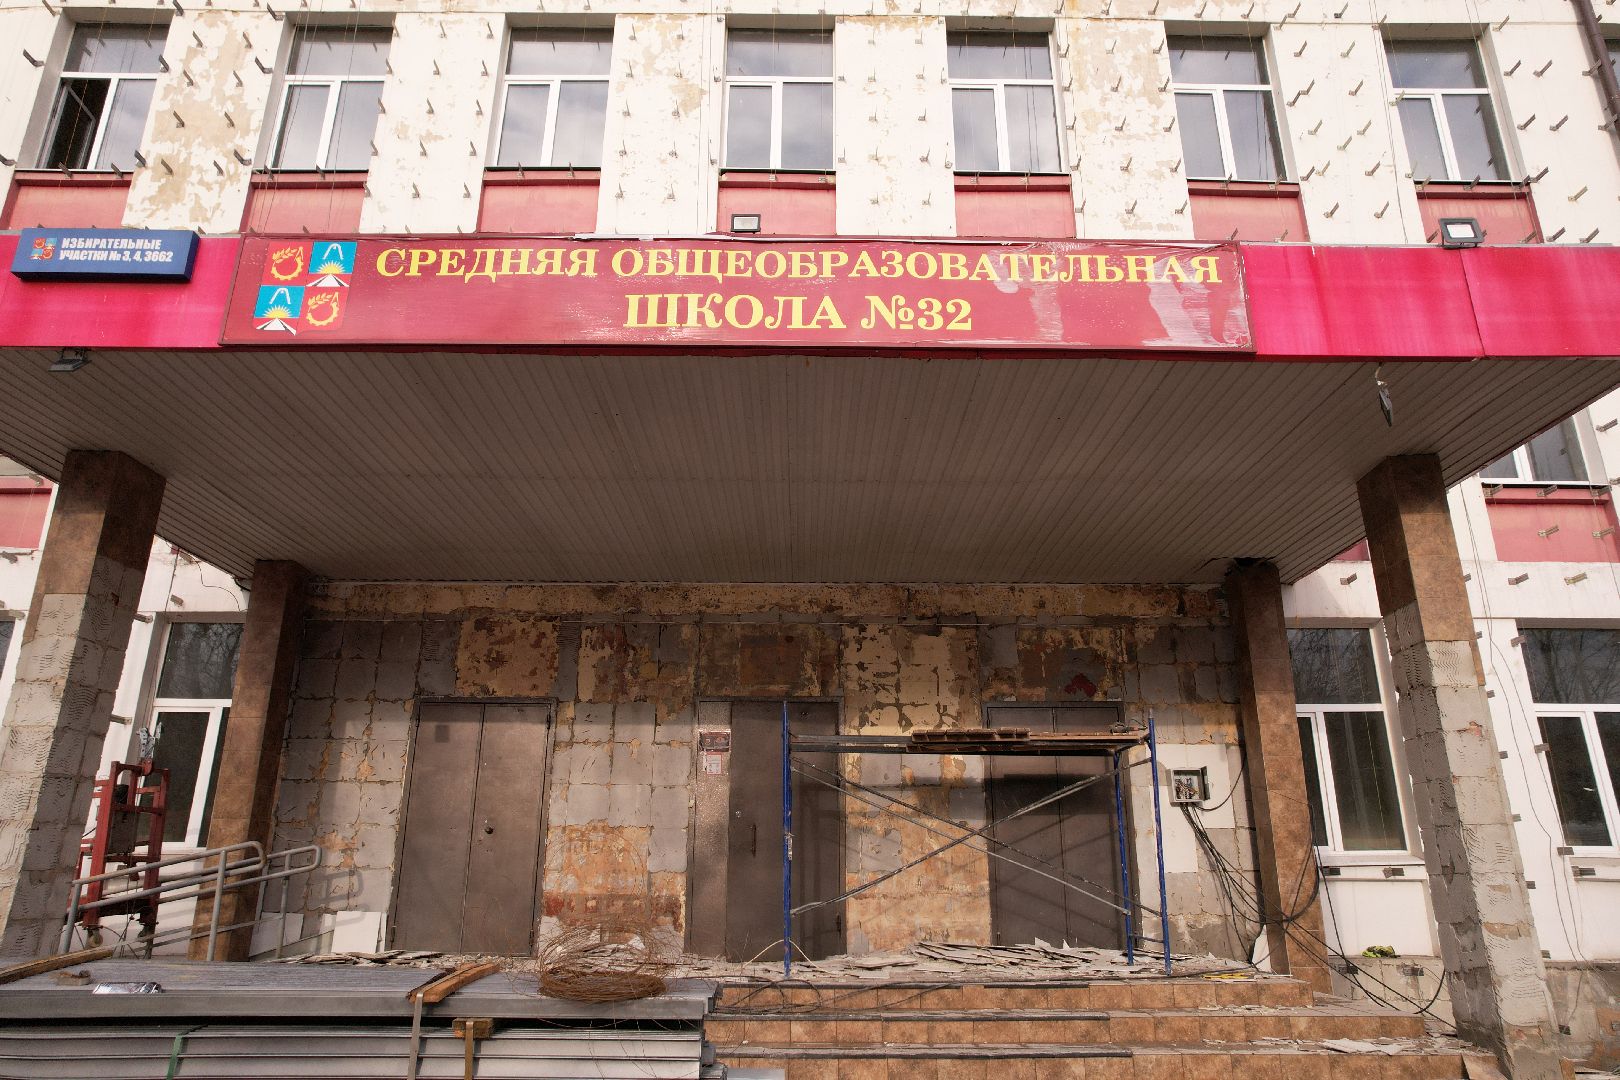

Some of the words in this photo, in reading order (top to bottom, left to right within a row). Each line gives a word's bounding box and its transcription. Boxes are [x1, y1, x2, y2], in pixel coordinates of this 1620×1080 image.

[61, 238, 162, 249] ИЗБИРАТЕЛЬНЫЕ
[59, 250, 109, 261] УЧАСТКИ
[122, 251, 131, 262] 3,
[133, 251, 142, 262] 4,
[144, 251, 174, 262] 3662
[376, 248, 600, 284] СРЕДНЯЯ
[611, 248, 1222, 284] ОБЩЕОБРАЗОВАТЕЛЬНАЯ
[623, 293, 846, 329] ШКОЛА
[860, 294, 972, 331] №32
